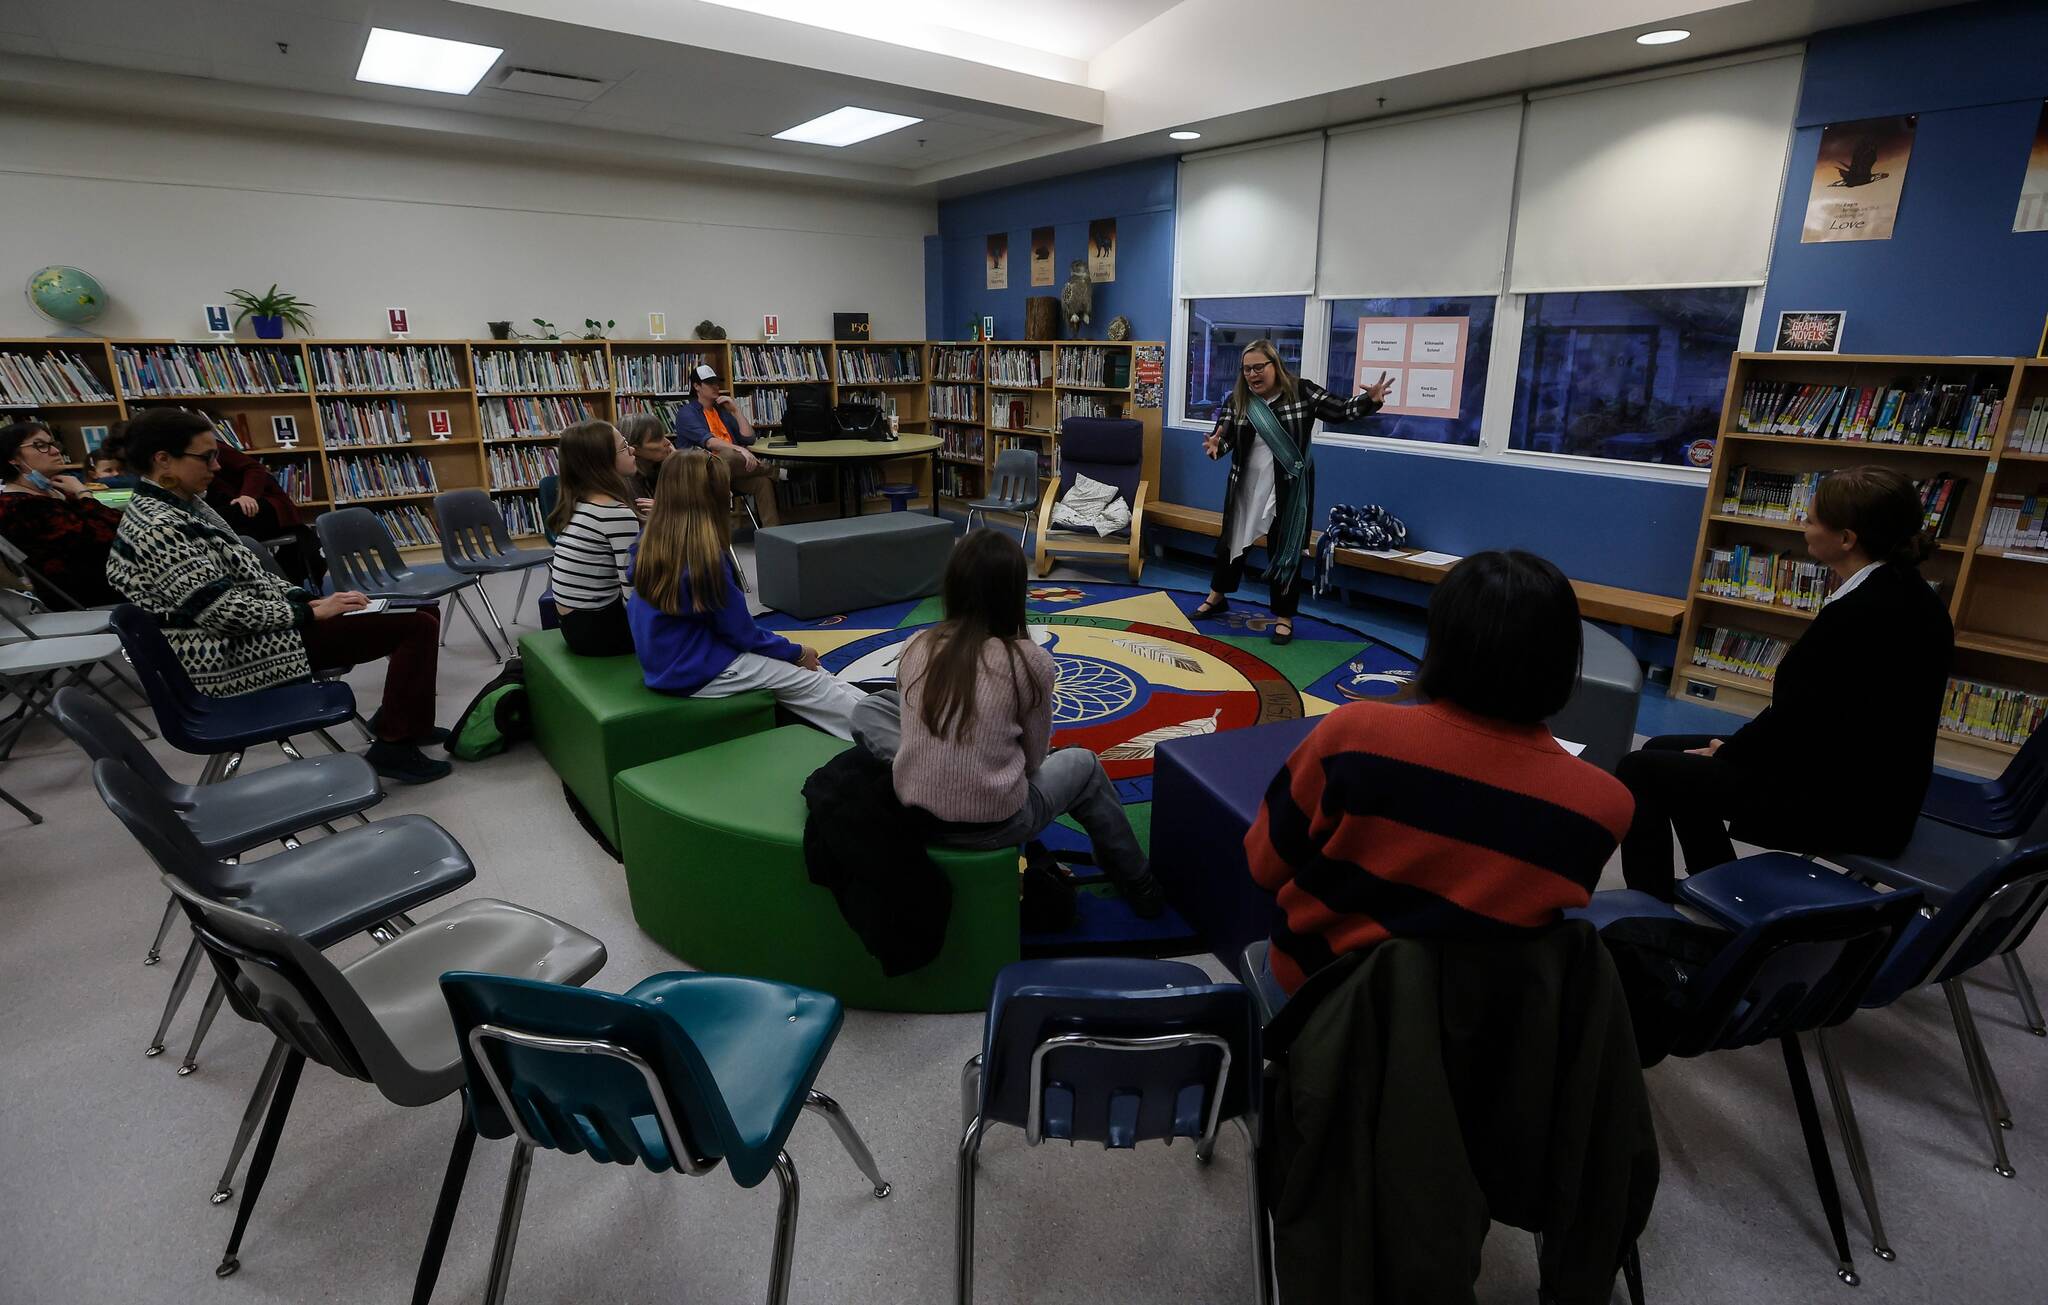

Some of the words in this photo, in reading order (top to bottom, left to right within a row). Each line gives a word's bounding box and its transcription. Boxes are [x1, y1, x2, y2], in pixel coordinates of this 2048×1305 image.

[1829, 219, 1865, 230] Love
[1792, 321, 1828, 331] GRAPHIC
[1791, 330, 1824, 341] NOVELS
[1025, 616, 1105, 626] MILITY
